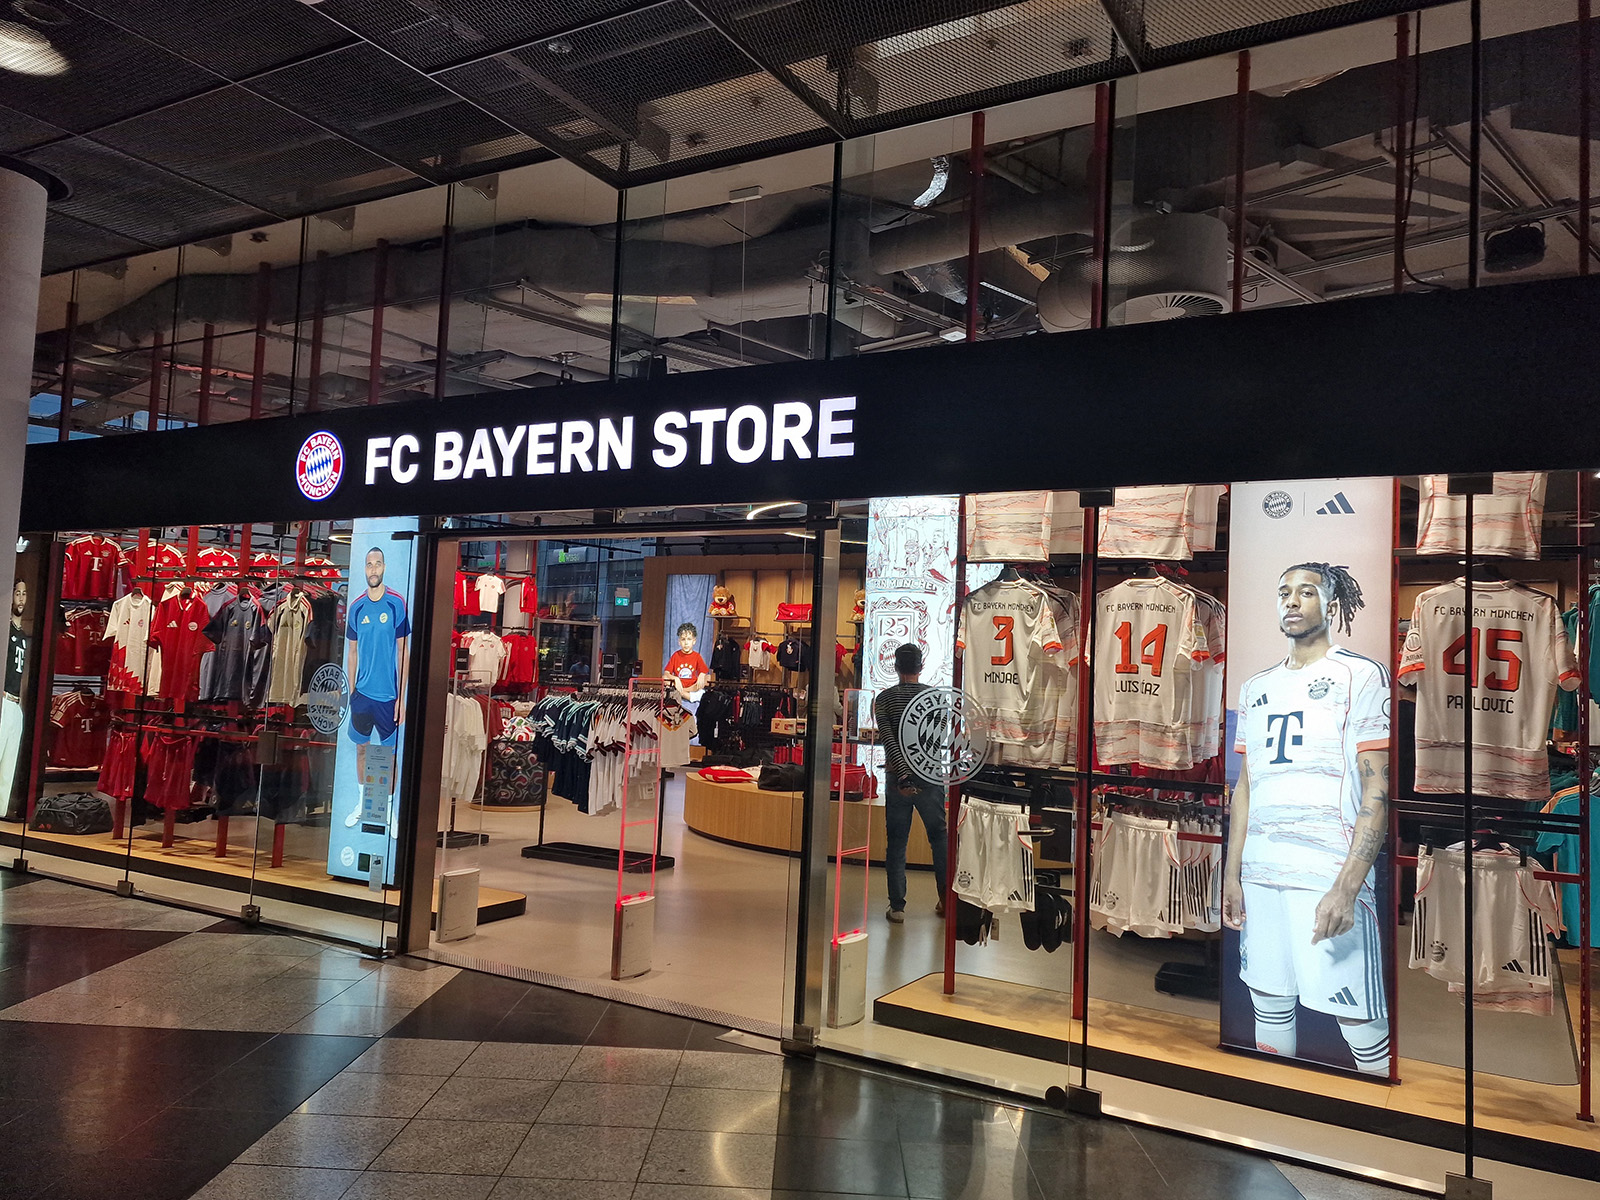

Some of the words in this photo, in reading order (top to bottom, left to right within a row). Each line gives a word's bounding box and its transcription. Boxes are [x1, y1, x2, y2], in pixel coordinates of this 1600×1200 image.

[300, 446, 311, 462] FC
[310, 435, 340, 460] BAYERN
[365, 434, 420, 485] FC
[433, 417, 634, 481] BAYERN
[652, 396, 857, 468] STORE
[1106, 604, 1115, 613] FC
[1117, 602, 1144, 612] BAYERN
[1434, 606, 1446, 616] FC
[879, 617, 909, 637] 125
[992, 615, 1015, 666] 3
[1114, 621, 1168, 677] 14
[1442, 627, 1523, 692] 45
[984, 672, 1019, 685] MINJAE
[1114, 680, 1139, 693] LUIS
[1446, 694, 1515, 714] PALOVIĆ
